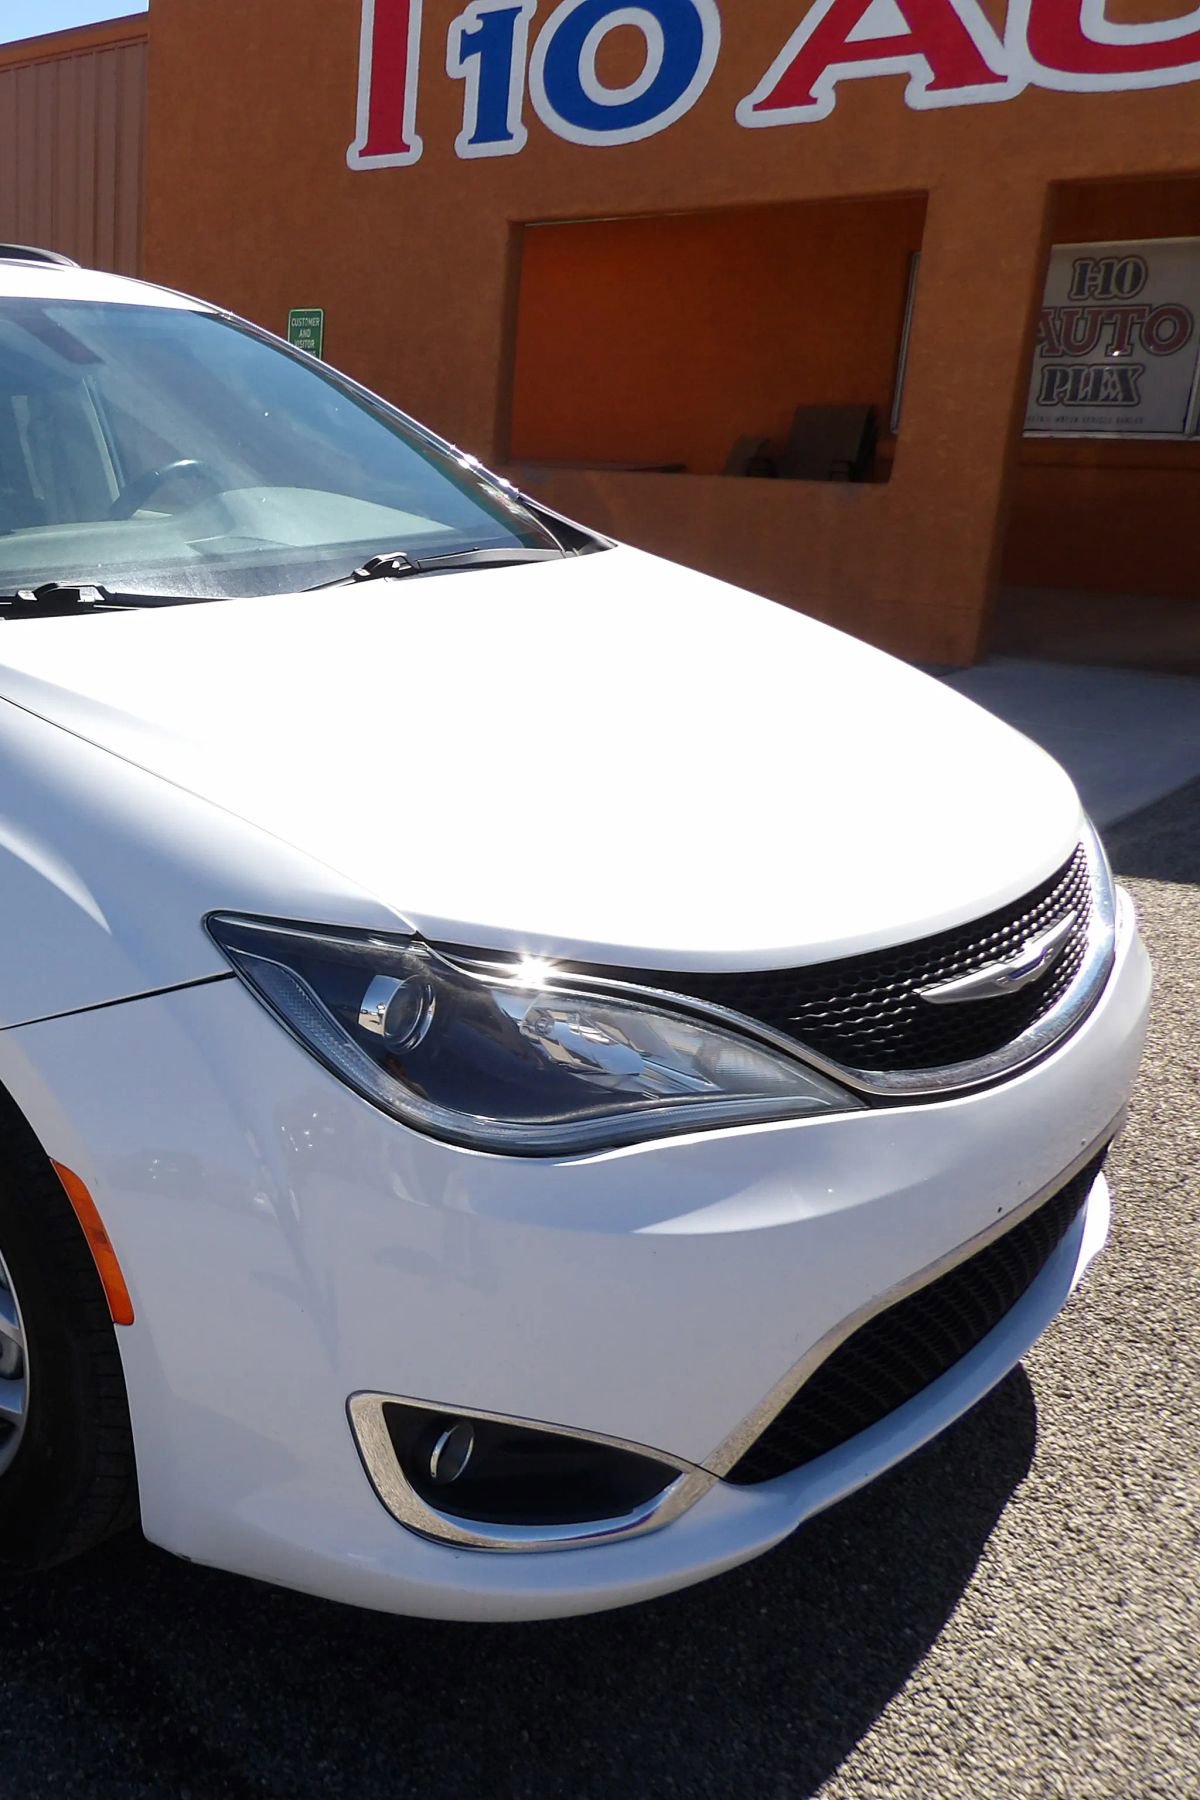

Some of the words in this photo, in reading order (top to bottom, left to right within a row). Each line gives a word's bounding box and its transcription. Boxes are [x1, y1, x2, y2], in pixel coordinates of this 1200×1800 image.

[291, 317, 320, 327] CUSTOMER
[299, 328, 311, 338] AND
[1036, 304, 1194, 357] AUTO
[1037, 363, 1146, 407] PLEX
